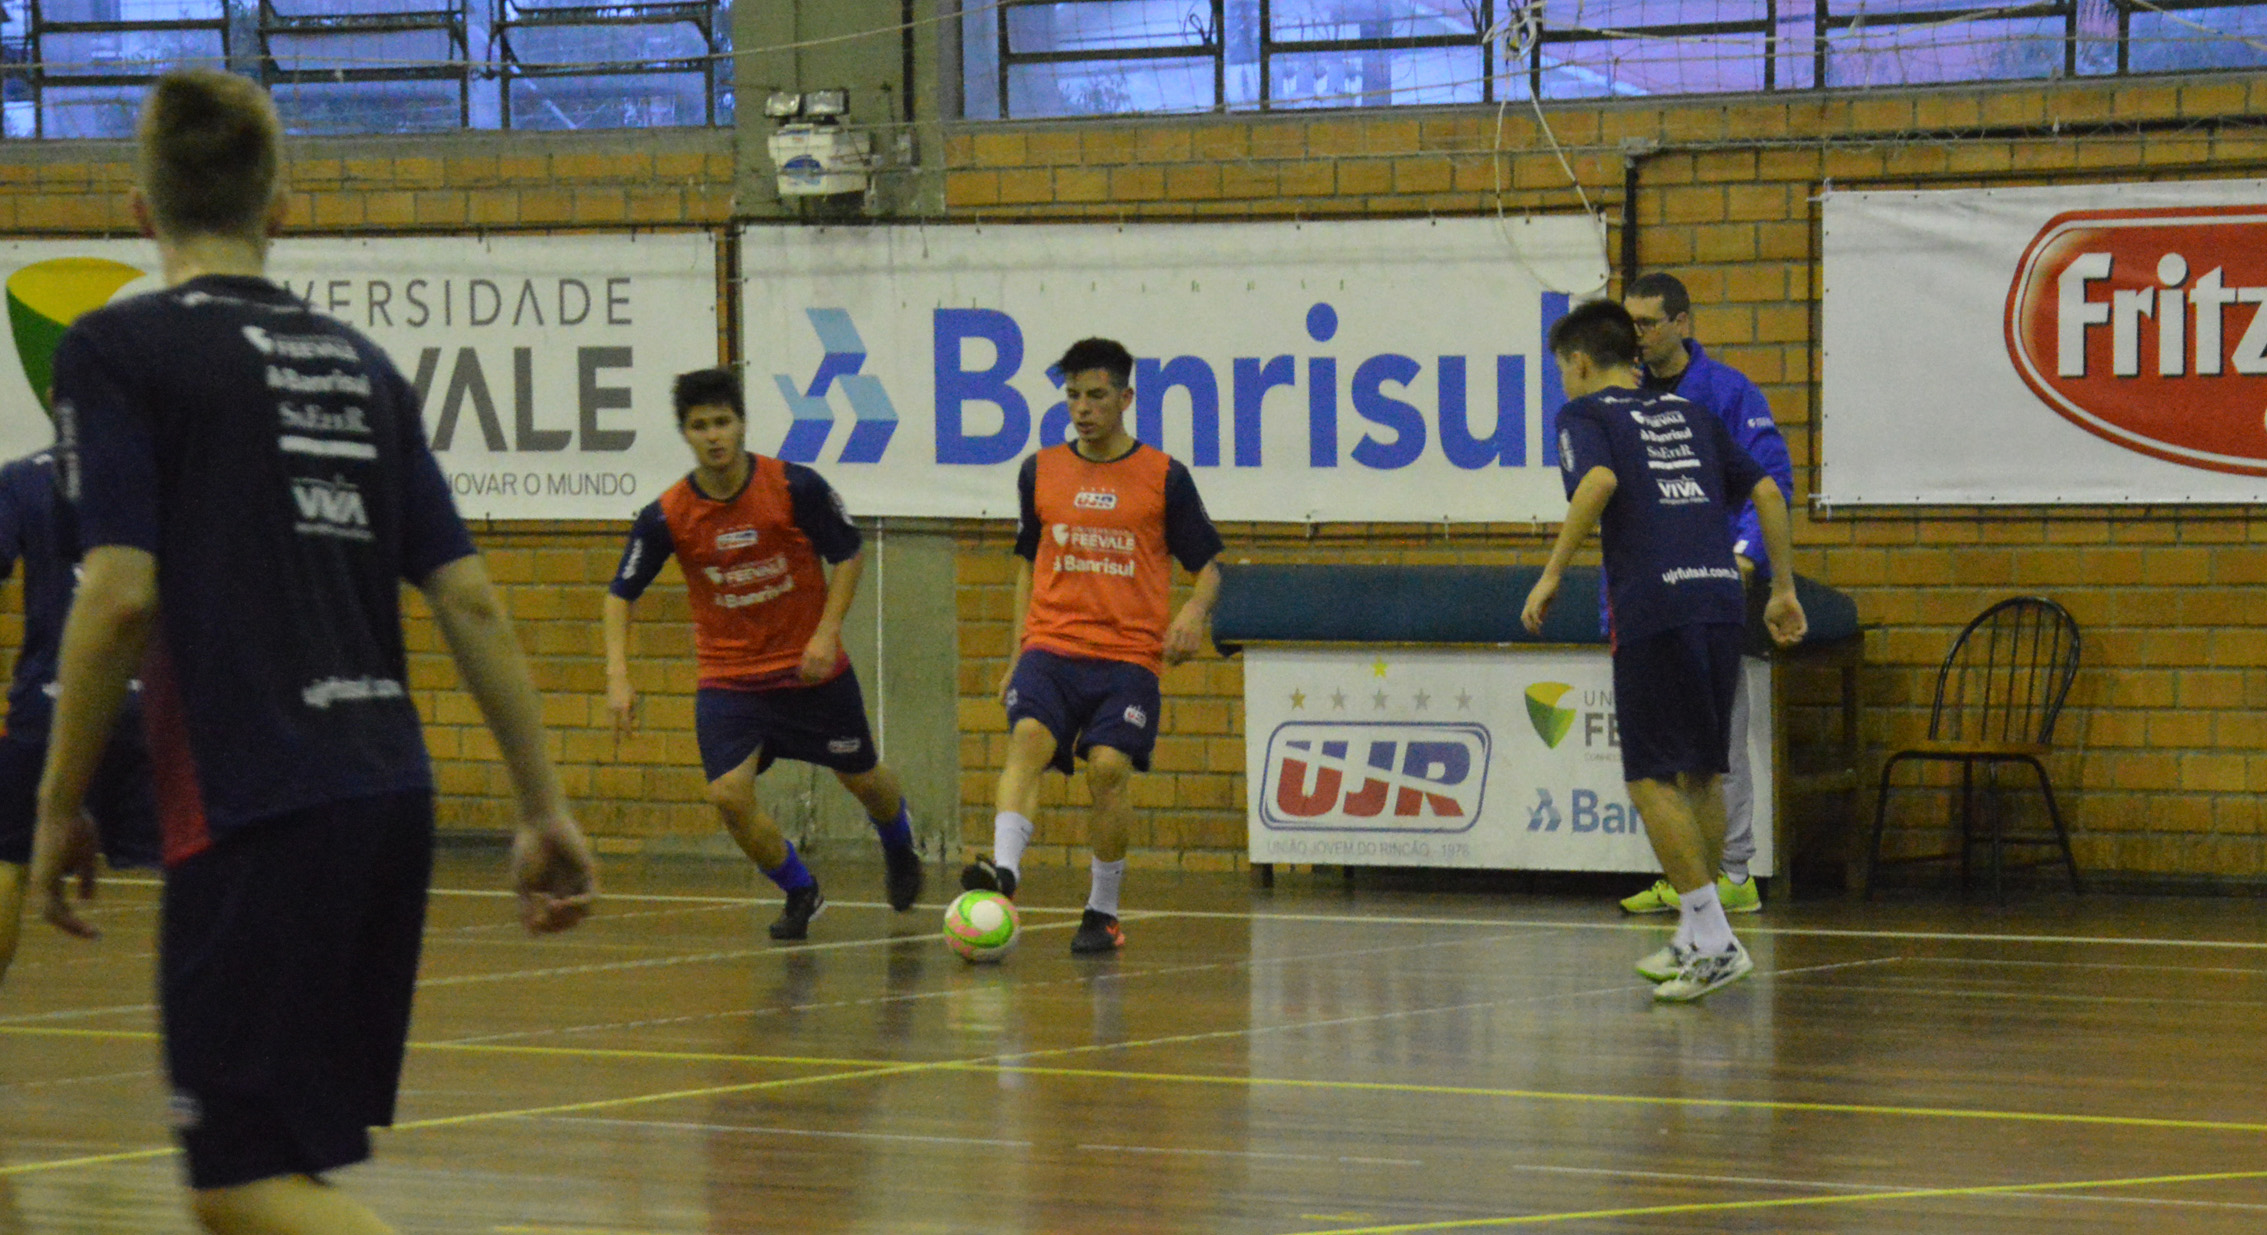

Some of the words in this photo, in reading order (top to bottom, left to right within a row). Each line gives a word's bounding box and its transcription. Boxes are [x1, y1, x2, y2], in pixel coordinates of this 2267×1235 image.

[284, 277, 632, 327] VERSIDADE
[524, 473, 541, 496] O
[547, 472, 637, 496] MUNDO
[1657, 480, 1706, 498] VIVA
[1071, 533, 1135, 552] FEEVALE
[1064, 554, 1135, 577] Banrisul
[1276, 739, 1471, 818] UJR
